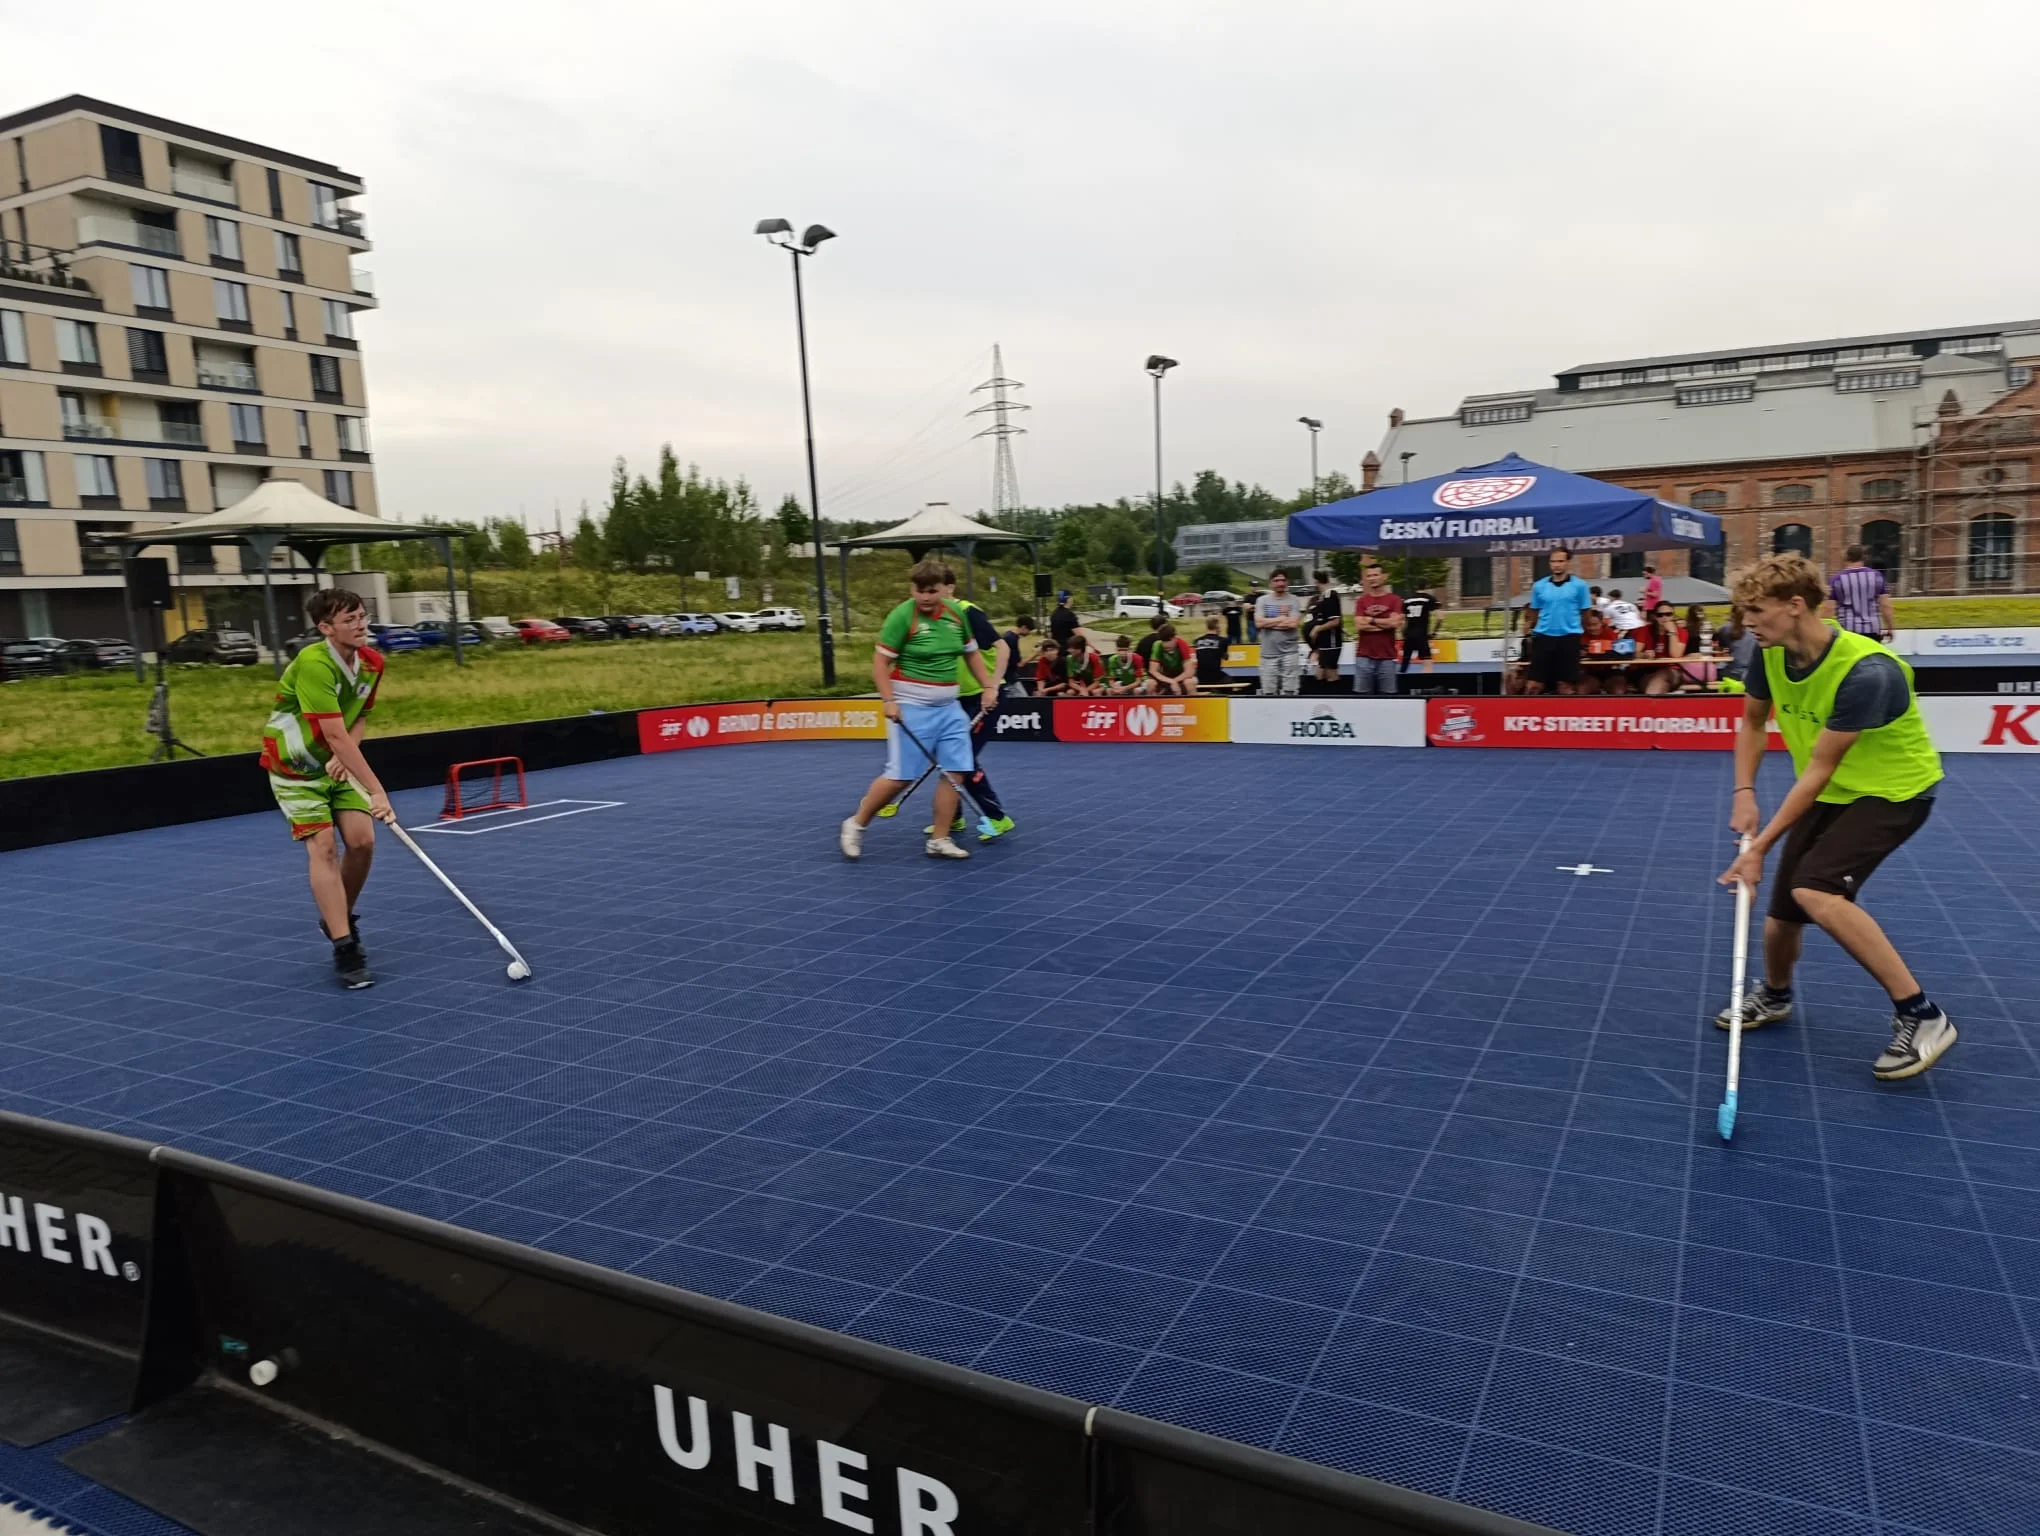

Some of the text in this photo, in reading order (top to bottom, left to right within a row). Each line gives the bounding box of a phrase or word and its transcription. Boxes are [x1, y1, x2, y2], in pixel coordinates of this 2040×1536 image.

[1379, 516, 1539, 540] ČESKÝ FLORBAL
[1290, 721, 1356, 738] HOLBA
[1503, 716, 1542, 732] KFC
[1543, 716, 1616, 732] STREET
[1617, 716, 1732, 734] FLOORBALL
[653, 1384, 959, 1536] UHER
